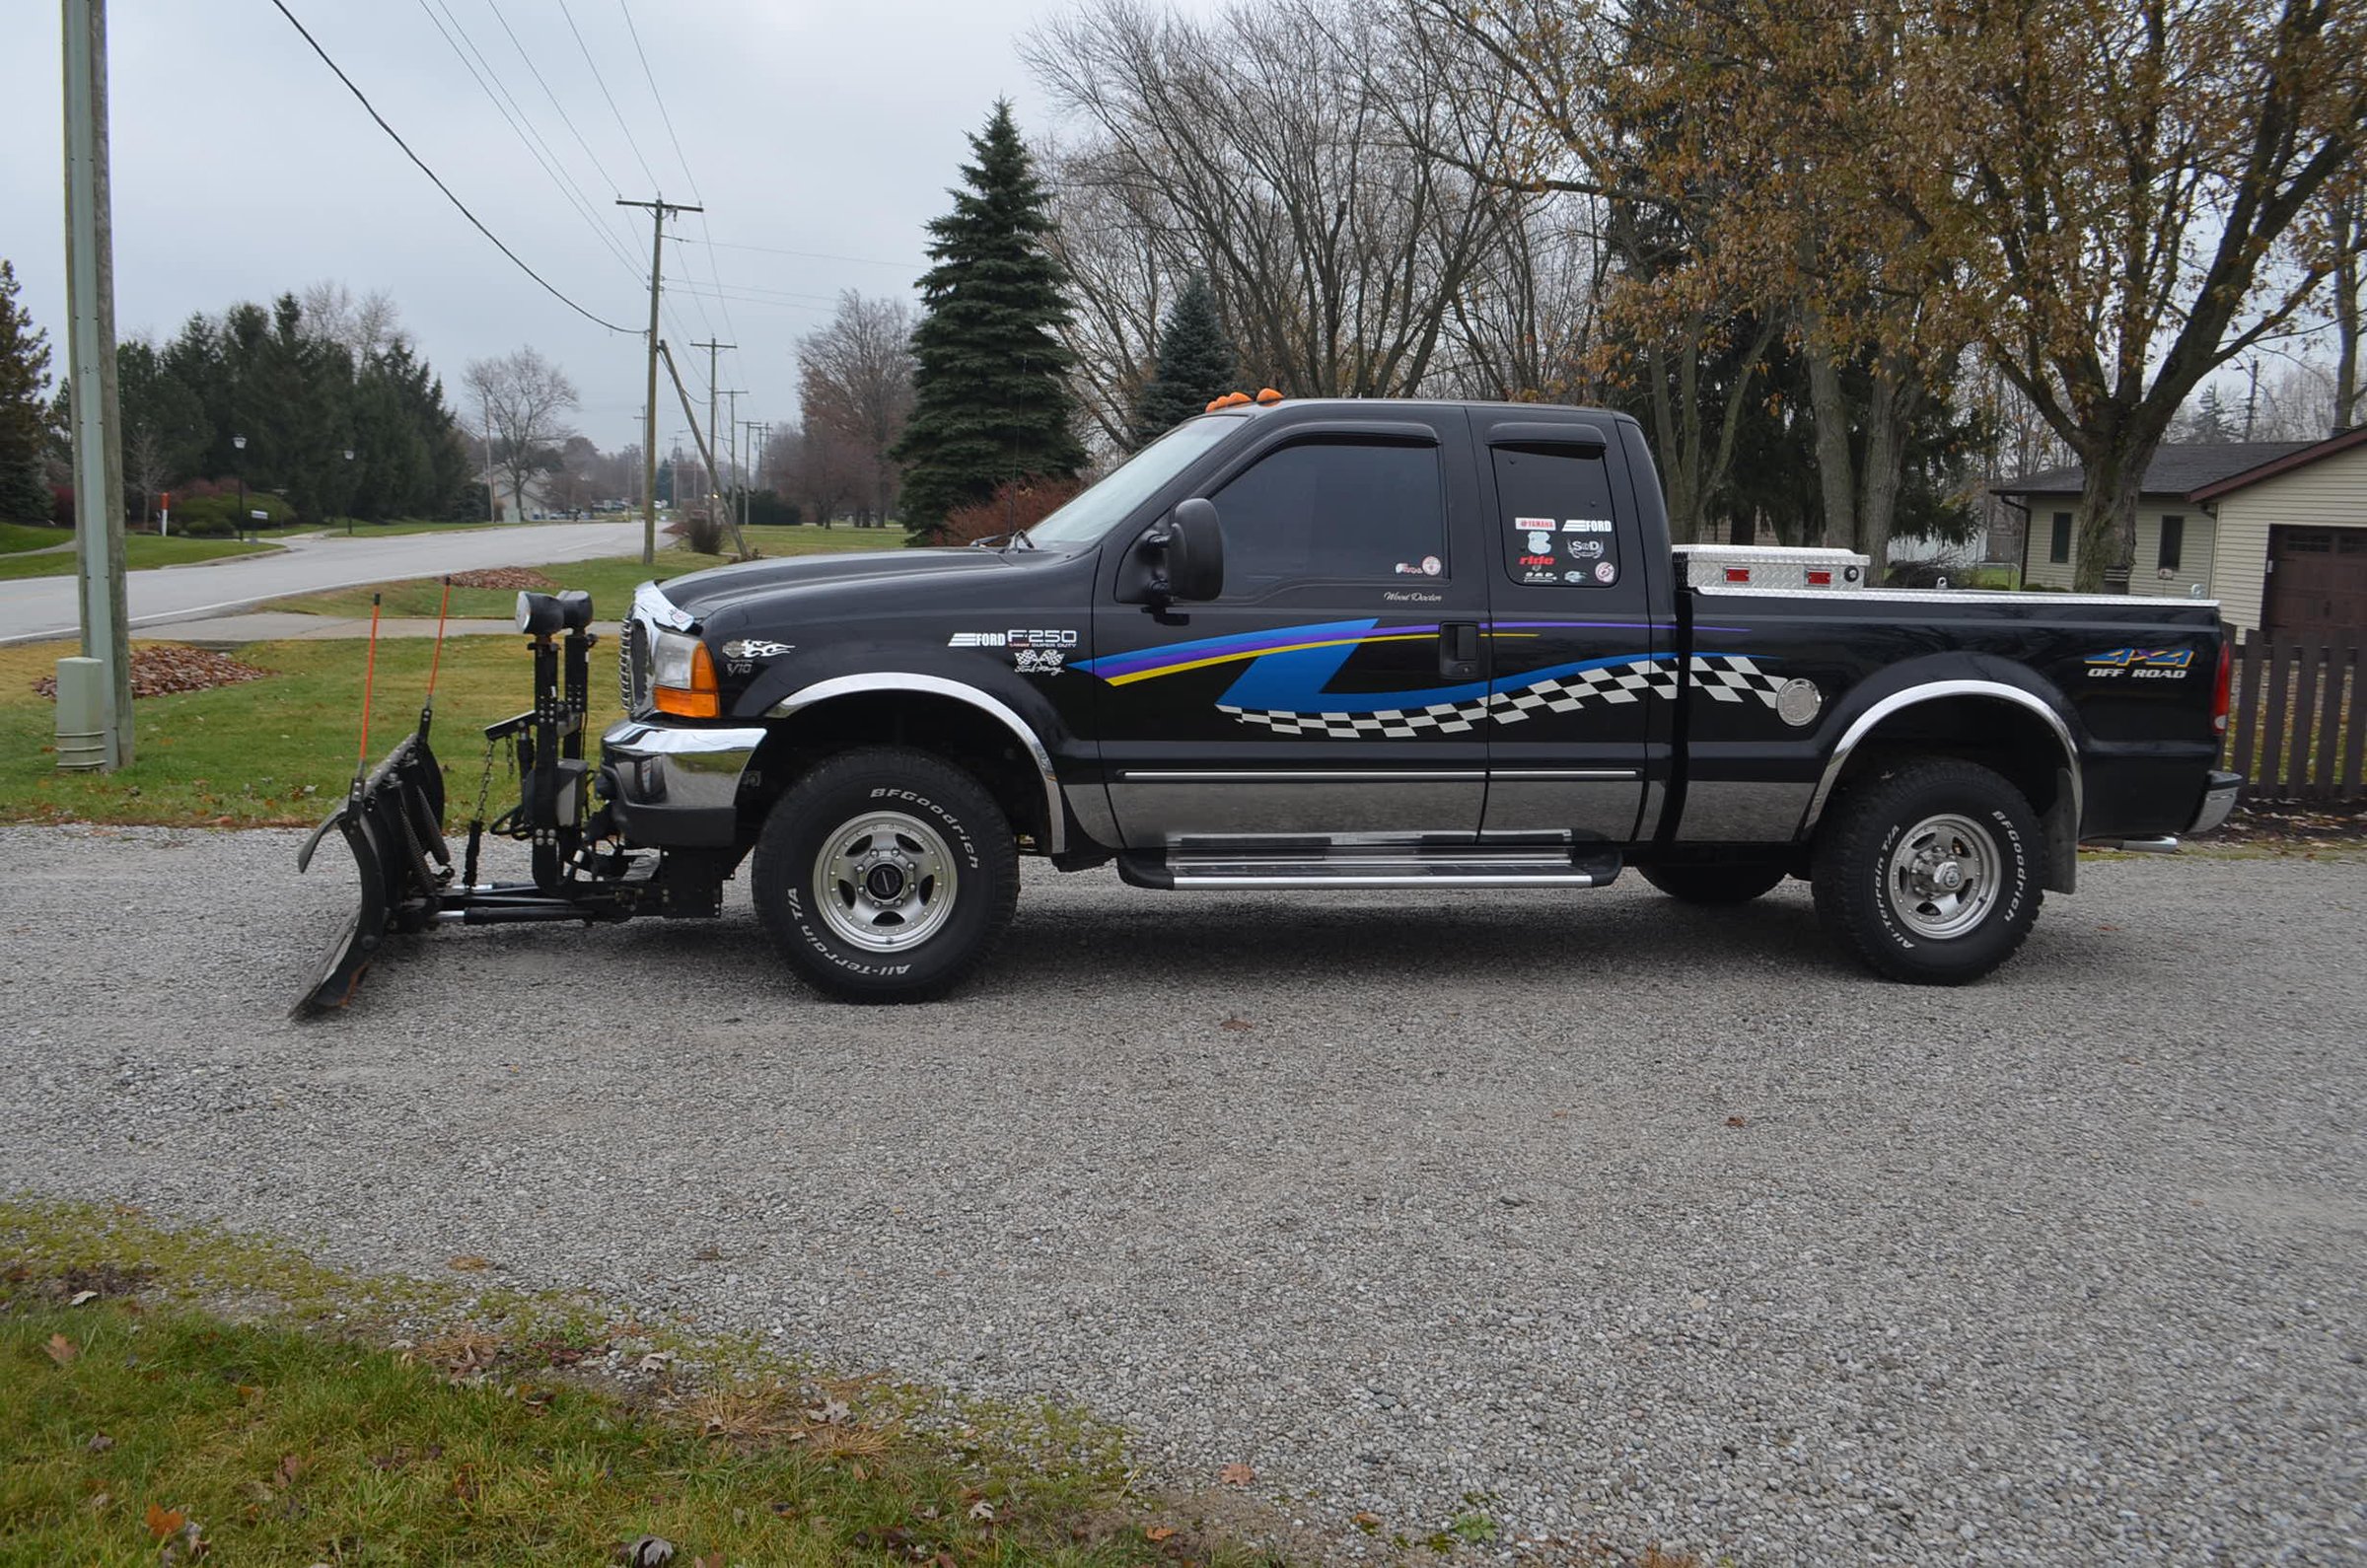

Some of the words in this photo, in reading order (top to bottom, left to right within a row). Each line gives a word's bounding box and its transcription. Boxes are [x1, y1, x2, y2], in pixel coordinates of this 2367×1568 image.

[1586, 520, 1612, 532] FORD
[976, 633, 1005, 646] FORD
[2088, 669, 2124, 677] OFF
[2131, 669, 2188, 678] ROAD
[787, 888, 803, 921] T/A
